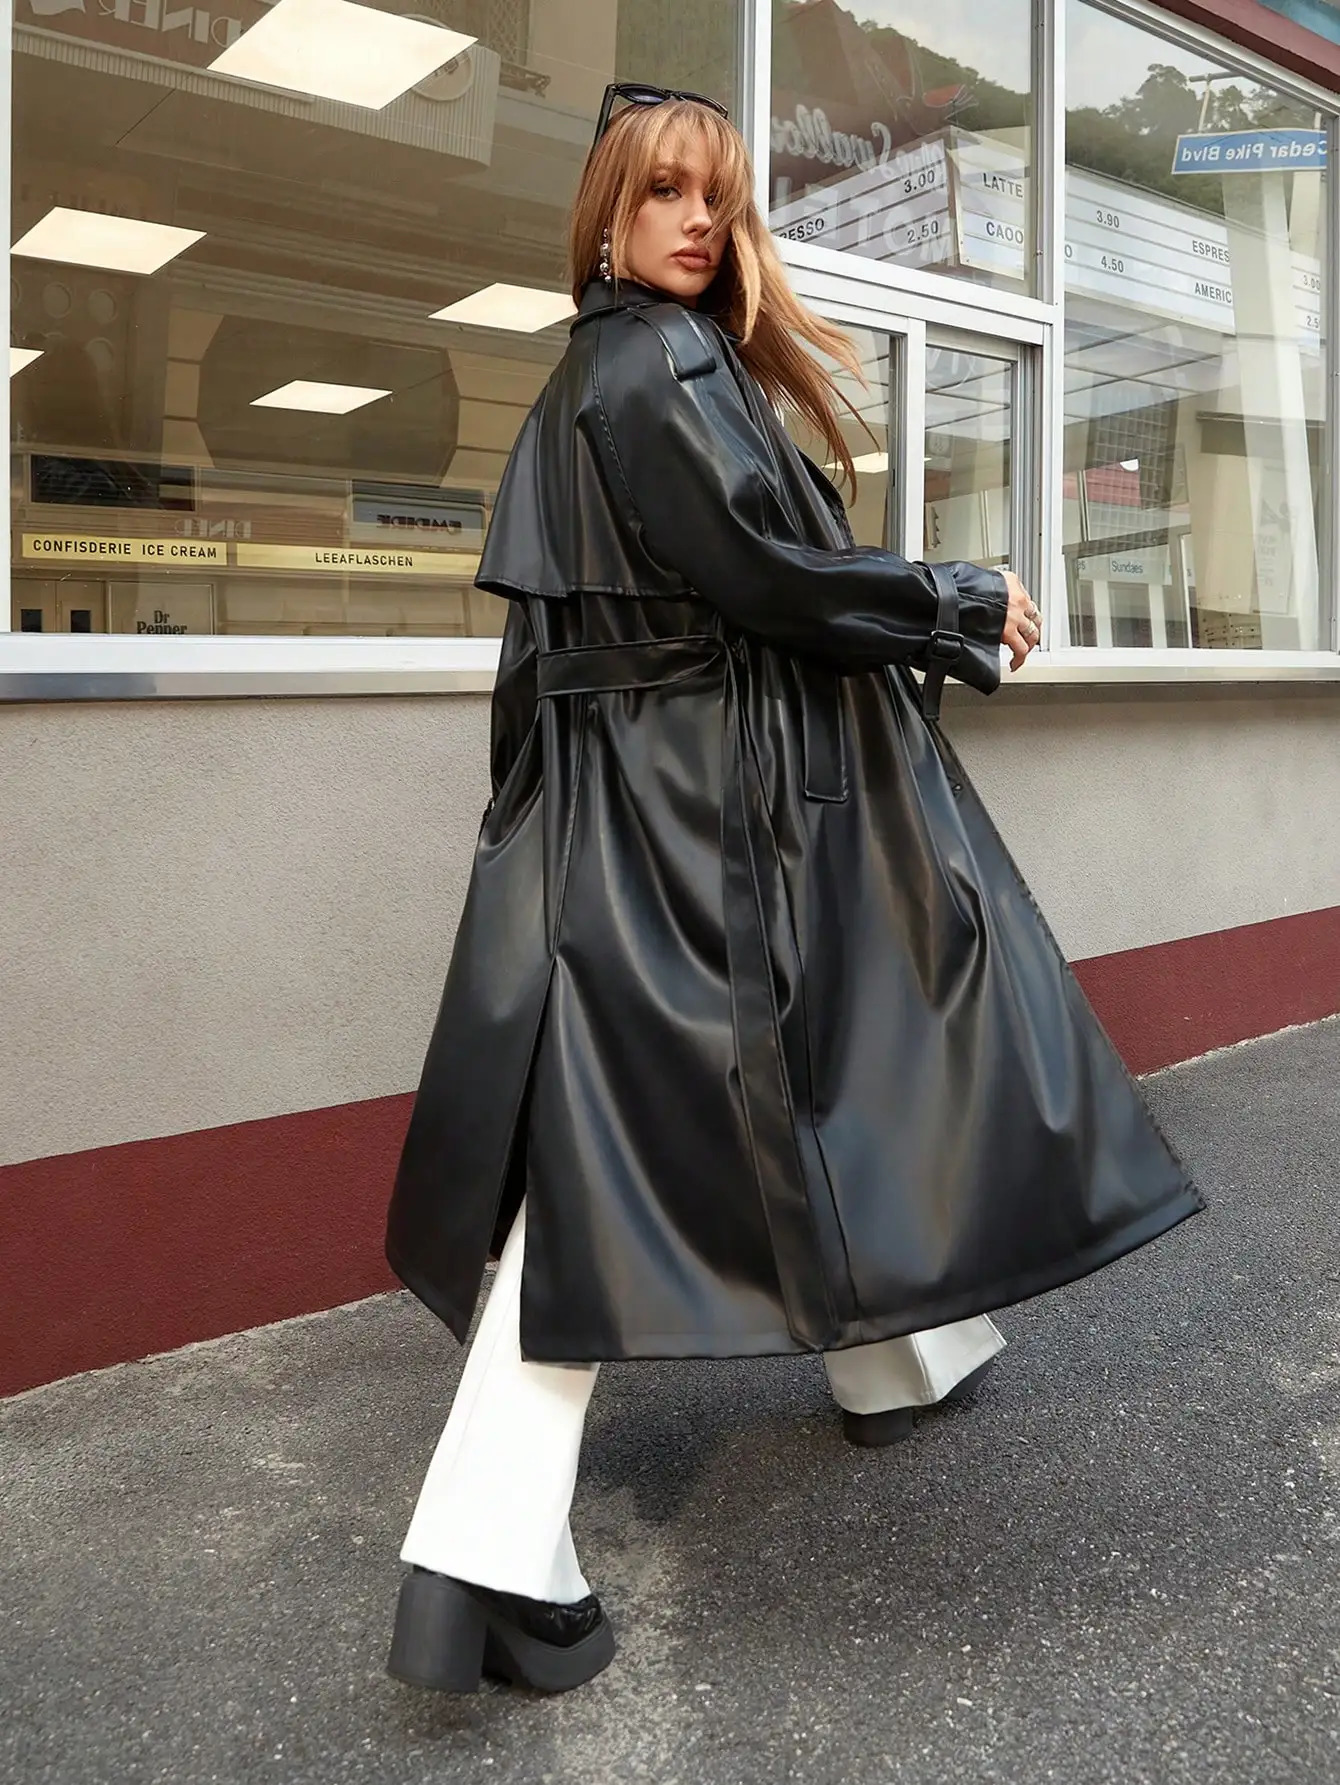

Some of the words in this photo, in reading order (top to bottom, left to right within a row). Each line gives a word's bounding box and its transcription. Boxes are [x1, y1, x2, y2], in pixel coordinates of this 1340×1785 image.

[904, 170, 935, 194] 3.00
[983, 172, 1023, 198] LATTE
[1096, 210, 1120, 228] 3.90
[907, 220, 939, 243] 2.50
[1101, 256, 1124, 273] 4.50
[1194, 282, 1232, 304] AMERIC
[33, 539, 131, 555] CONFISDERIE
[142, 544, 164, 556] ICE
[170, 546, 217, 558] CREAM
[154, 610, 170, 624] Dr
